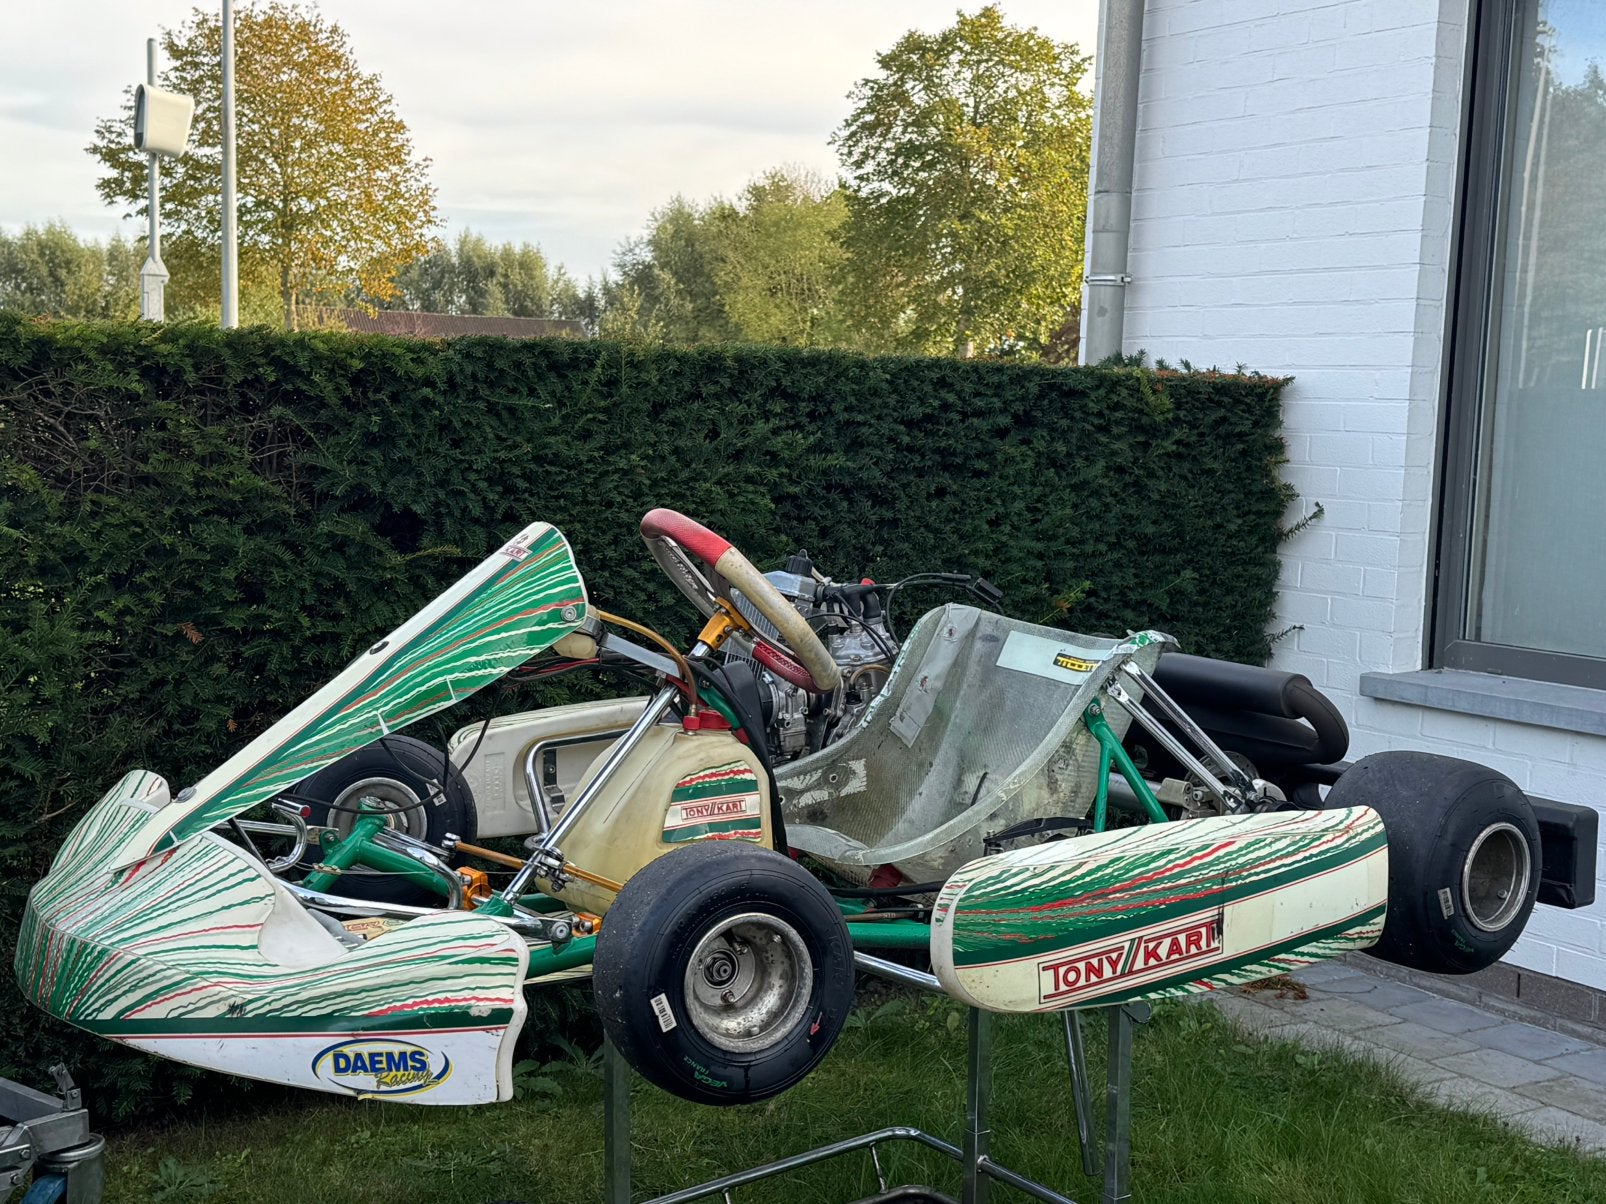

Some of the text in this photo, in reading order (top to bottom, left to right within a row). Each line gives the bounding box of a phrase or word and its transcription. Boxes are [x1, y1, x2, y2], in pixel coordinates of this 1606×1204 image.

[682, 800, 744, 818] TONY KART
[1042, 920, 1217, 992] TONY KART
[332, 1050, 429, 1076] DAEMS
